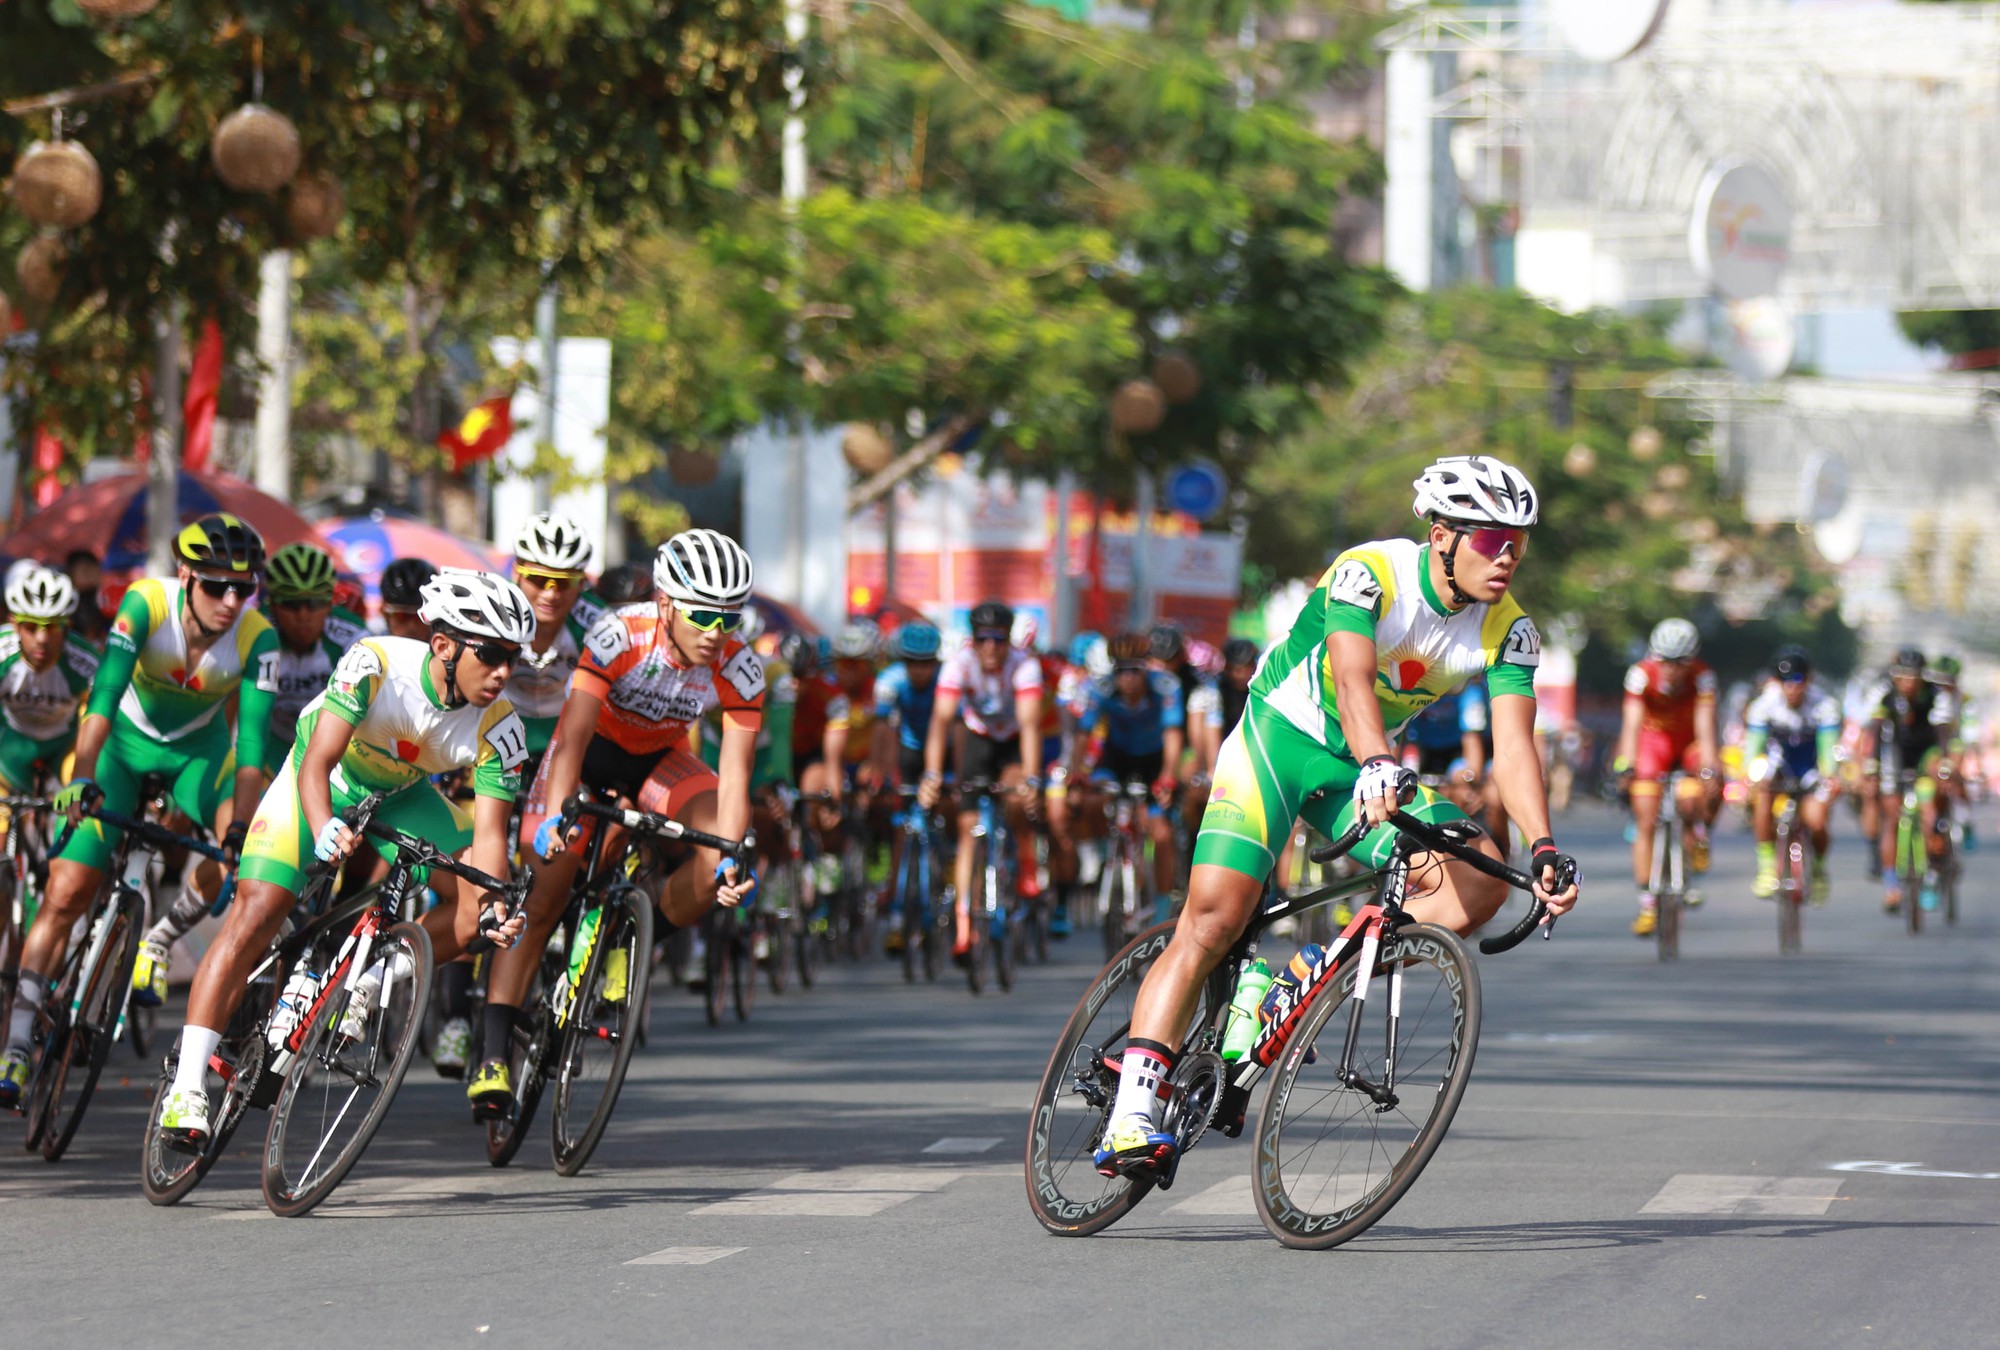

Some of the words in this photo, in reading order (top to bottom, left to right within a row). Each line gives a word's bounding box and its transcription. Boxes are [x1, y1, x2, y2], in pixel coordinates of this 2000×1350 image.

[1338, 569, 1378, 598] 112
[591, 623, 622, 650] 15
[737, 656, 763, 687] 15
[1086, 934, 1166, 1016] BORA
[1341, 937, 1465, 1080] CAMPAGNOO
[1034, 1104, 1133, 1220] CAMPAGNOL
